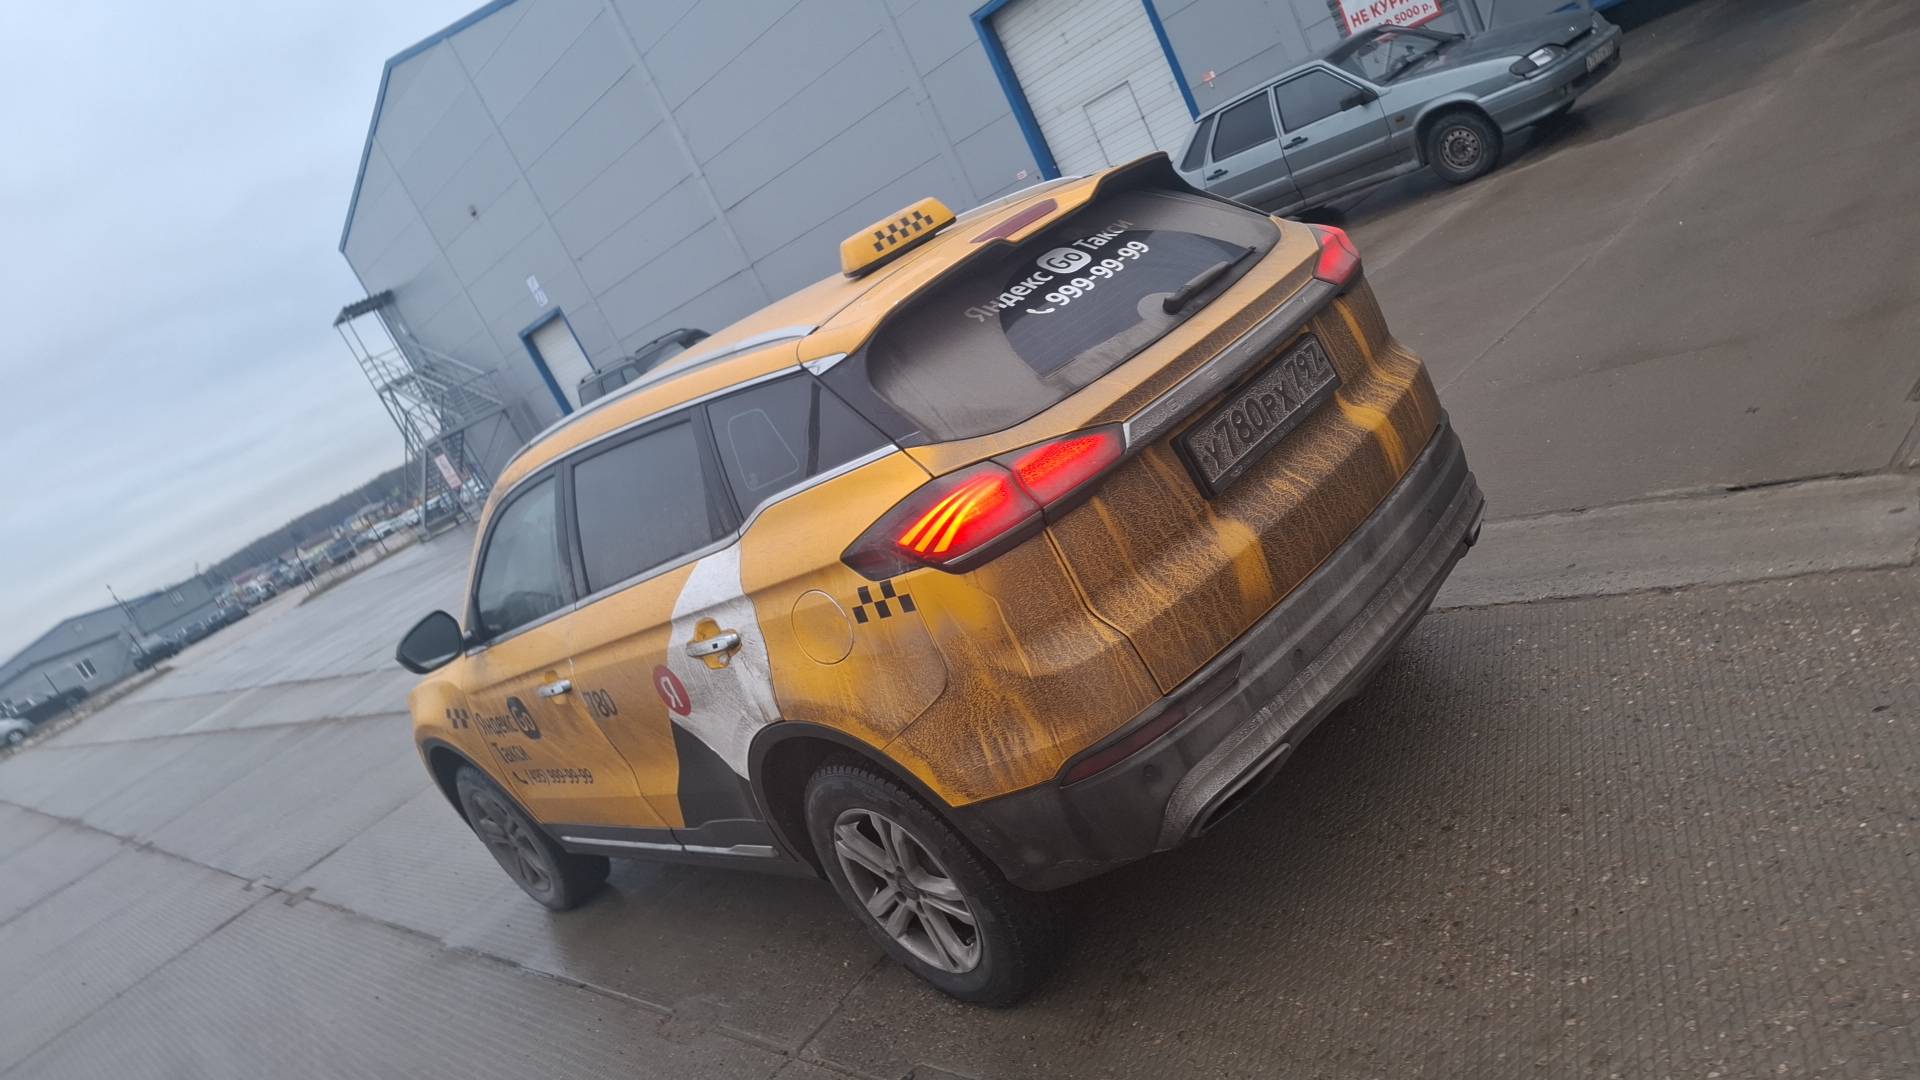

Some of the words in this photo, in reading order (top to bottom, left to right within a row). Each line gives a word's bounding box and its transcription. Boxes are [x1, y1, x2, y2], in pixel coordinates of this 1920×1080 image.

[1350, 9, 1370, 27] НЕ
[1369, 0, 1409, 18] КУР
[1394, 5, 1420, 24] 5000
[964, 271, 1054, 322] Яндекс
[1044, 251, 1085, 271] Go
[1072, 219, 1134, 250] Такси
[1045, 240, 1149, 306] 999-99-99
[581, 688, 618, 718] 780
[660, 675, 684, 708] Я
[475, 712, 519, 738] Яндекс
[509, 703, 538, 734] Go
[490, 742, 530, 765] Такси
